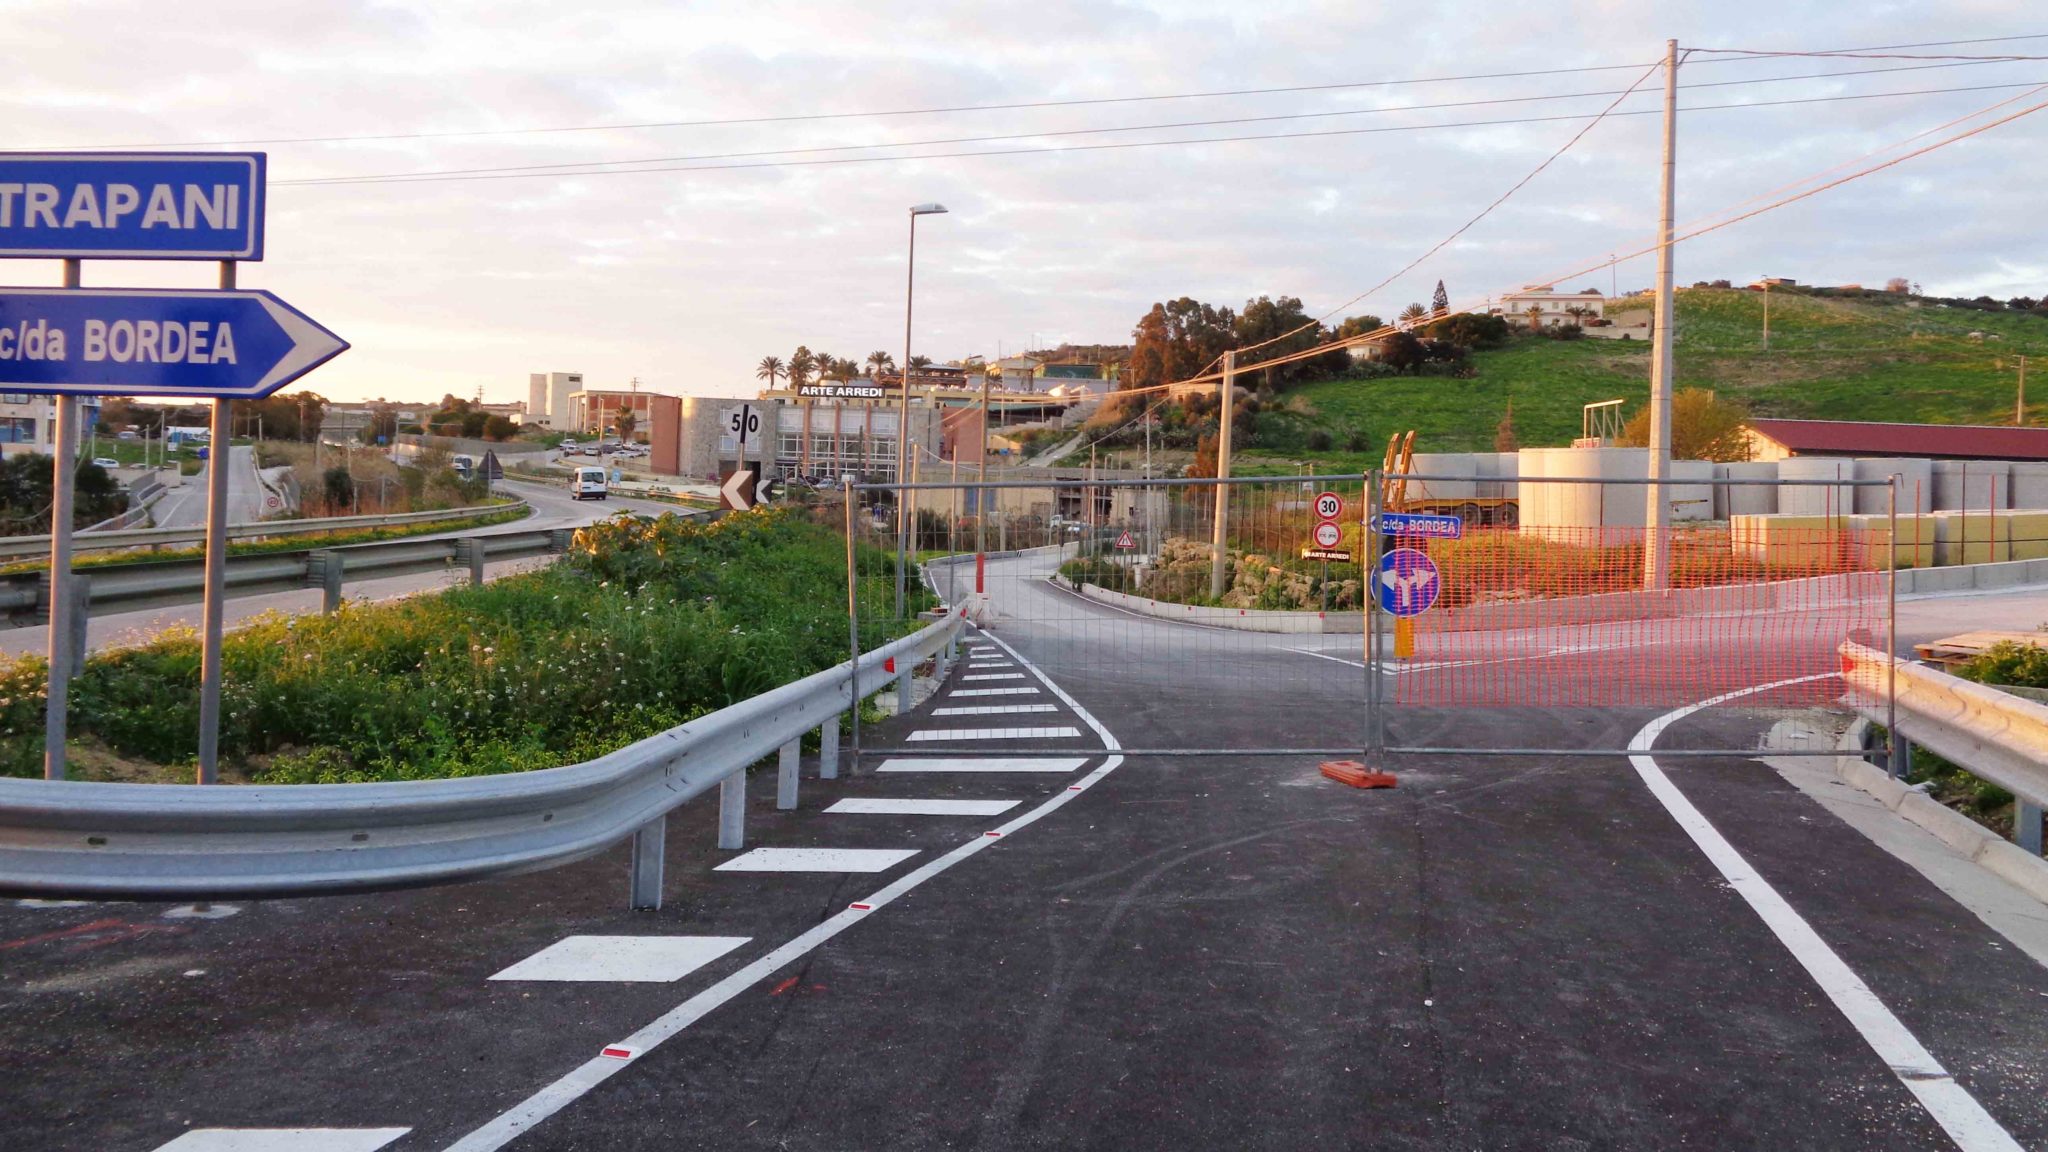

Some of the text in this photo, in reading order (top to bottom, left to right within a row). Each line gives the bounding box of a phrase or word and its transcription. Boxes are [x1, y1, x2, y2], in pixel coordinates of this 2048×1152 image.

[0, 182, 240, 230] TRAPANI
[0, 319, 238, 365] c/da BORDEA
[801, 386, 882, 397] ARTE ARREDI
[1321, 500, 1336, 513] 30
[1382, 519, 1456, 534] c/da BORDEA
